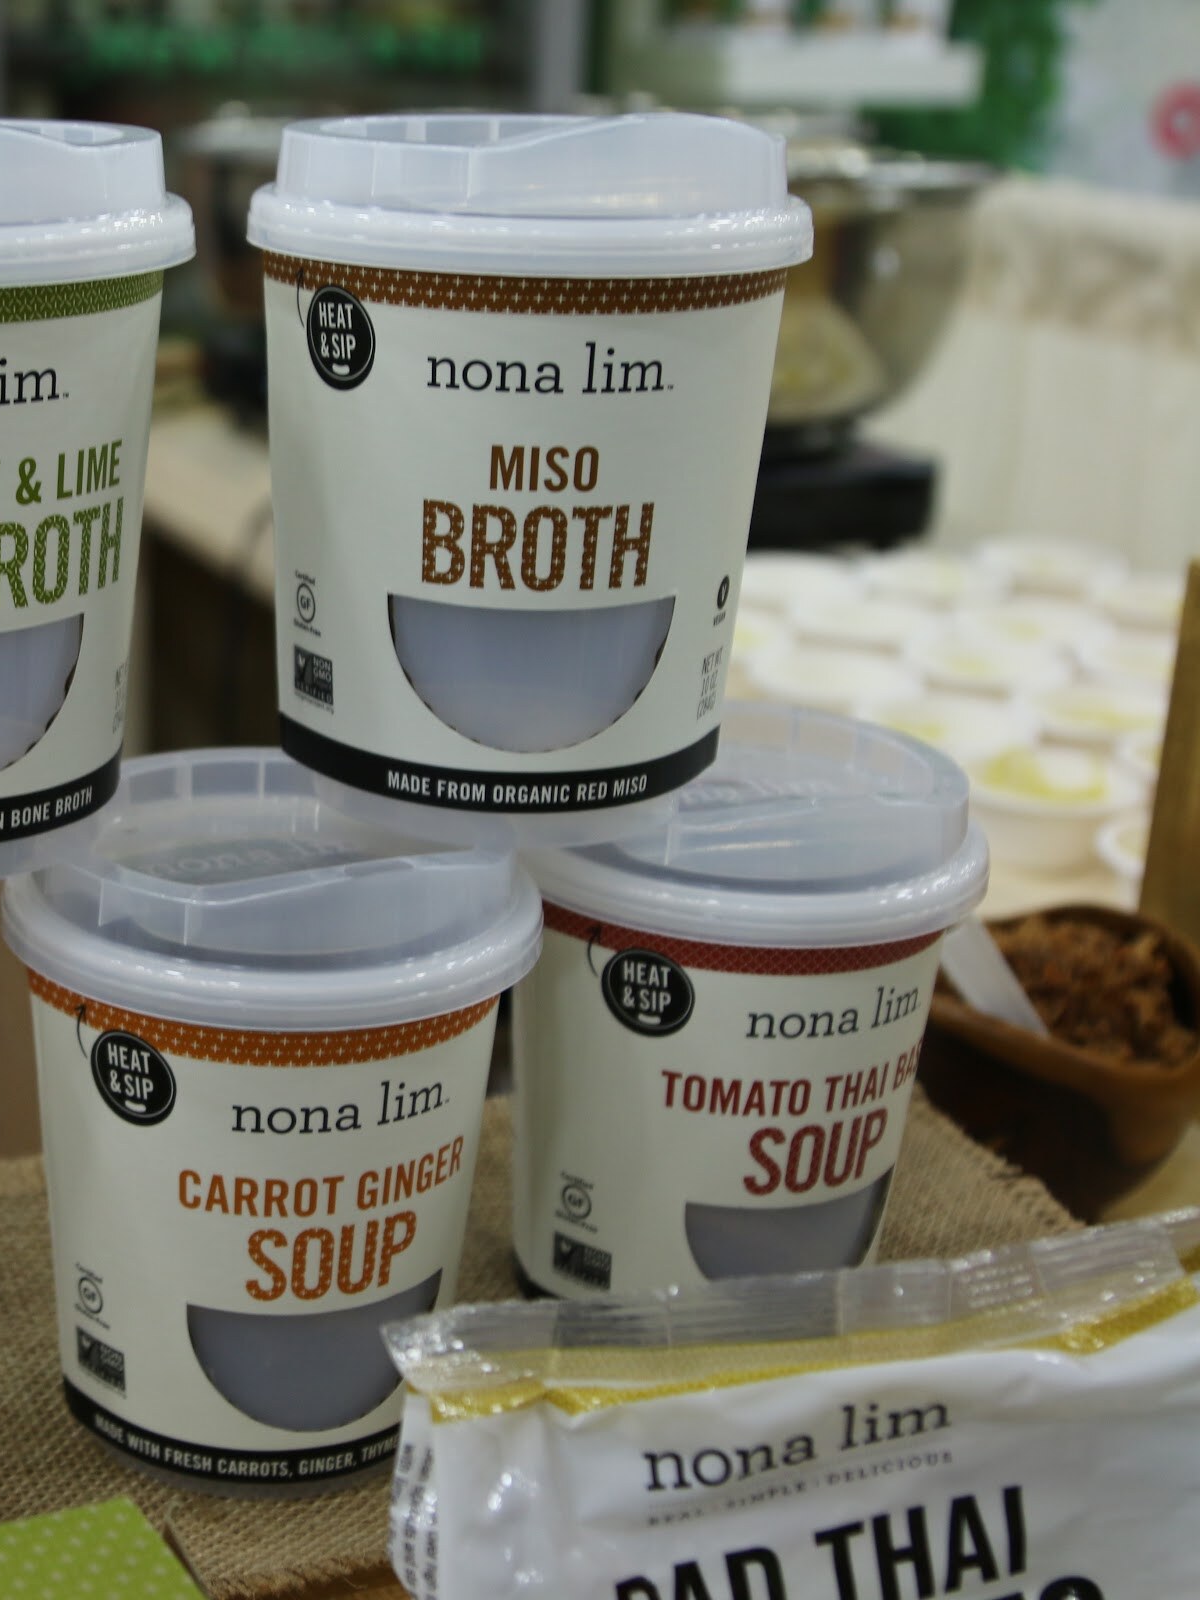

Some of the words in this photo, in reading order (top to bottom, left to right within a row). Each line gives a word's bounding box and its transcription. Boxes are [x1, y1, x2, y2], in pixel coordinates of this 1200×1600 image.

[319, 302, 354, 330] HEAT
[320, 332, 330, 358] &
[331, 333, 356, 360] SIP
[427, 355, 564, 394] nona
[582, 342, 665, 394] lim
[15, 457, 43, 505] &
[56, 439, 122, 499] LIME
[489, 444, 600, 492] MISO
[421, 498, 655, 592] BROTH
[10, 801, 51, 829] BONE
[55, 785, 94, 818] BROTH
[387, 770, 432, 796] MADE
[437, 779, 487, 802] FROM
[493, 784, 570, 804] ORGANIC
[576, 781, 608, 801] RED
[612, 774, 649, 799] MISO
[623, 959, 671, 988] HEAT
[623, 985, 635, 1008] &
[640, 988, 672, 1013] SIP
[746, 1008, 860, 1040] nona
[871, 985, 919, 1028] lim
[107, 1042, 151, 1075] HEAT
[110, 1069, 122, 1094] &
[124, 1074, 154, 1101] SIP
[232, 1102, 361, 1135] nona
[378, 1080, 444, 1126] lim
[661, 1070, 811, 1117] TOMATO
[825, 1061, 889, 1112] THAI
[178, 1168, 344, 1218] CARROT
[357, 1135, 464, 1210] GINGER
[742, 1107, 888, 1197] SOUP
[245, 1210, 417, 1301] SOUP
[127, 1434, 161, 1460] WITH
[164, 1447, 212, 1472] FRESH
[217, 1458, 294, 1479] CARROTS,
[299, 1453, 357, 1476] GINGER,
[643, 1430, 817, 1493] nona
[840, 1402, 951, 1452] lim
[815, 1485, 1028, 1600] THAI
